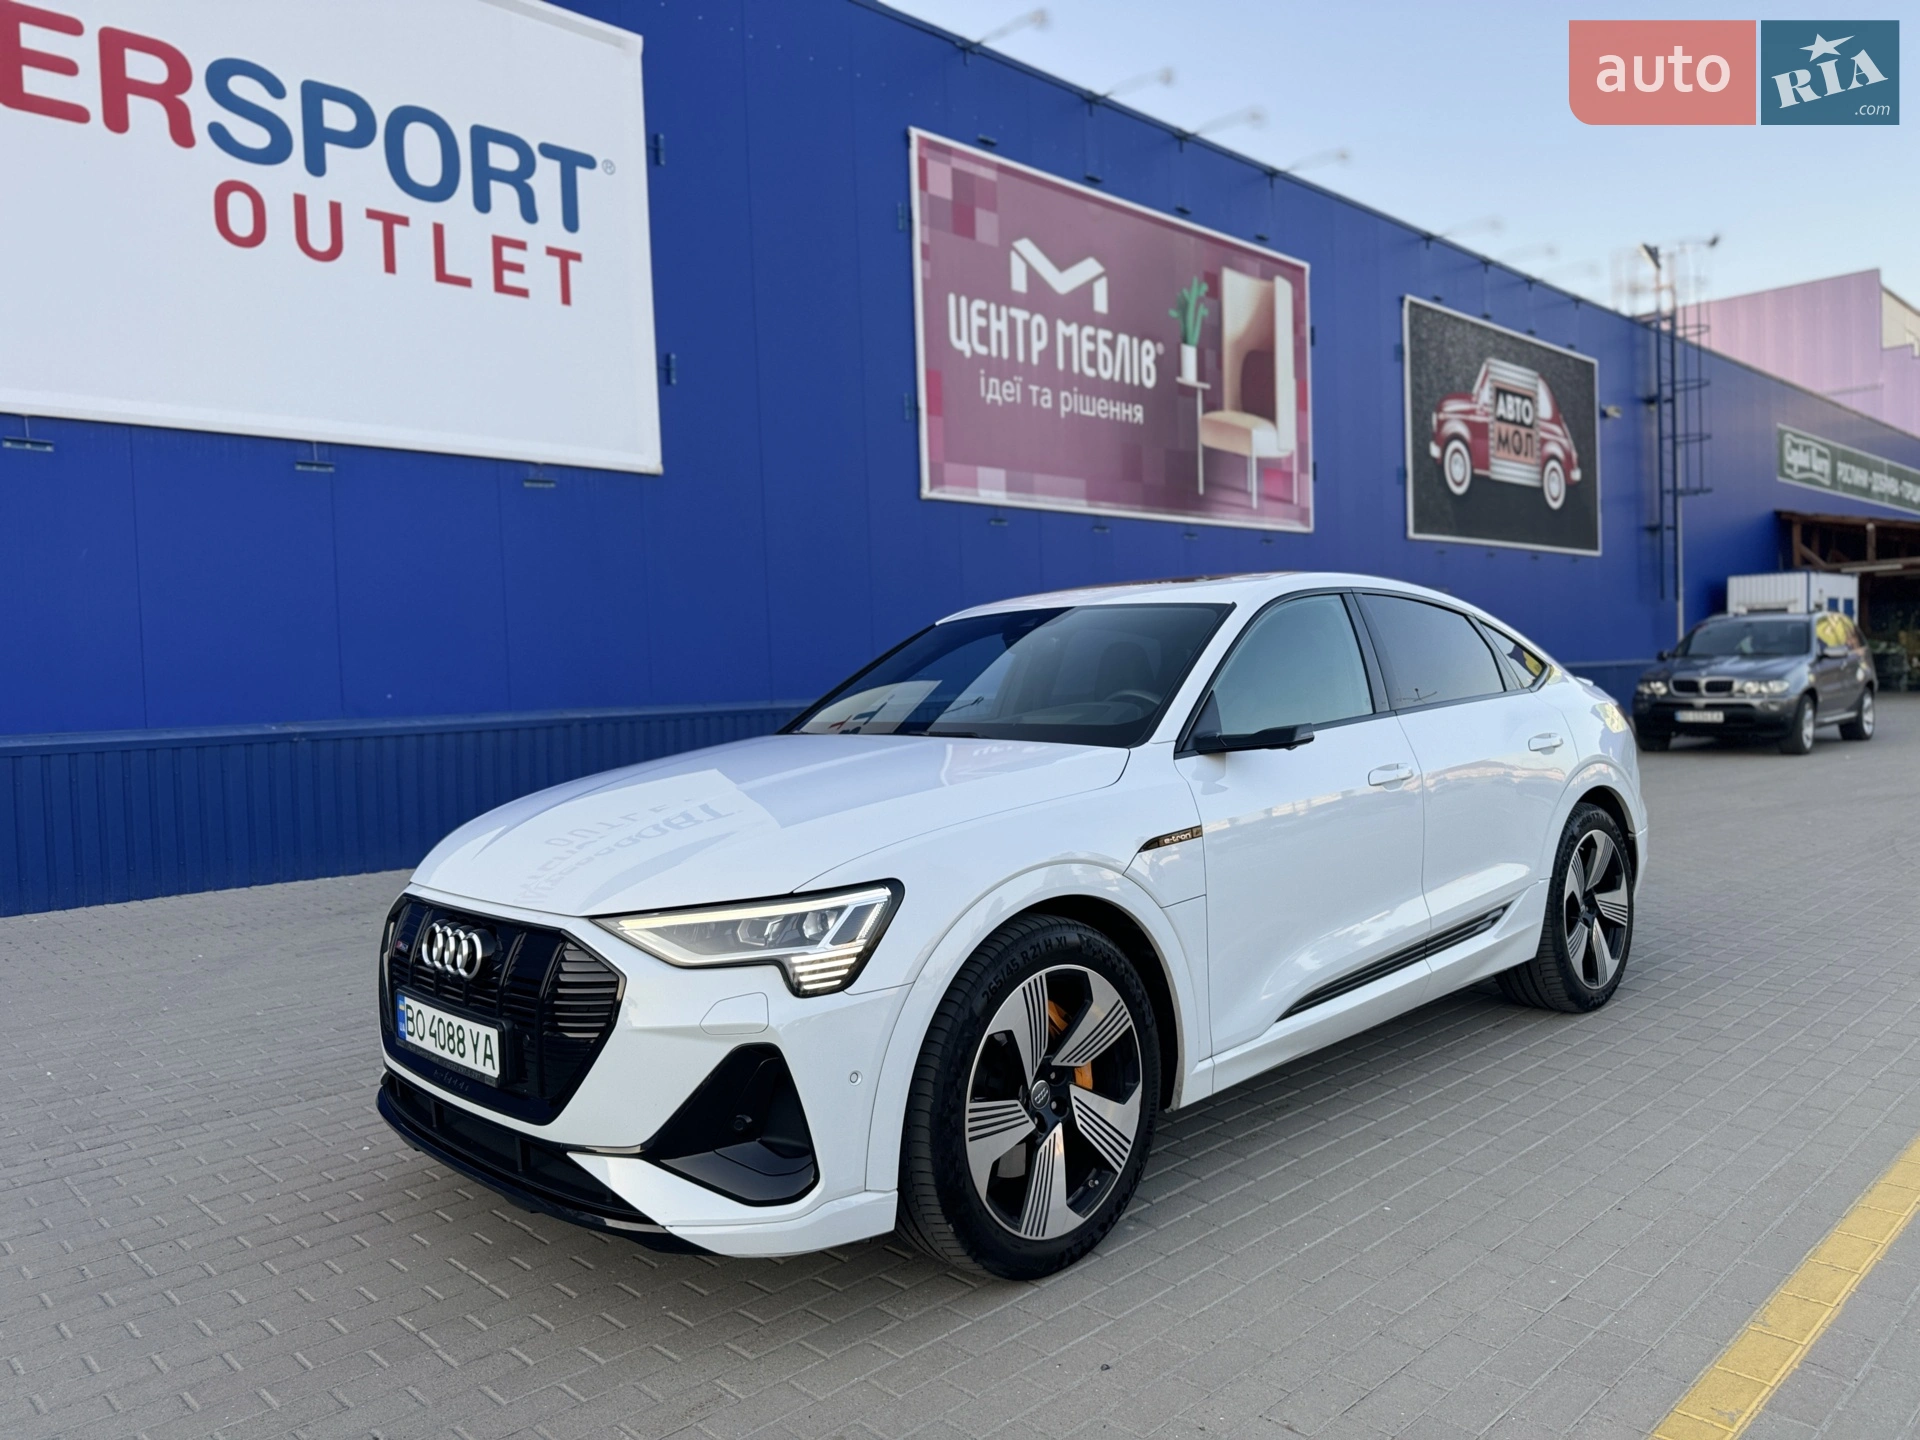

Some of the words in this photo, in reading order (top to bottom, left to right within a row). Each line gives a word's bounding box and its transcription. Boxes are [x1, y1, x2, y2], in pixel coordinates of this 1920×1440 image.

[213, 179, 583, 306] OUTLET
[948, 292, 1048, 366] ЦЕНТР
[1056, 318, 1157, 389] МЕБЛІВ
[979, 369, 1023, 406] ідеї
[1028, 385, 1053, 409] та
[1059, 388, 1144, 425] рішення
[1496, 392, 1534, 426] АВТО
[1164, 832, 1191, 844] e-tron
[429, 1014, 466, 1059] 4088
[469, 1028, 496, 1071] YA
